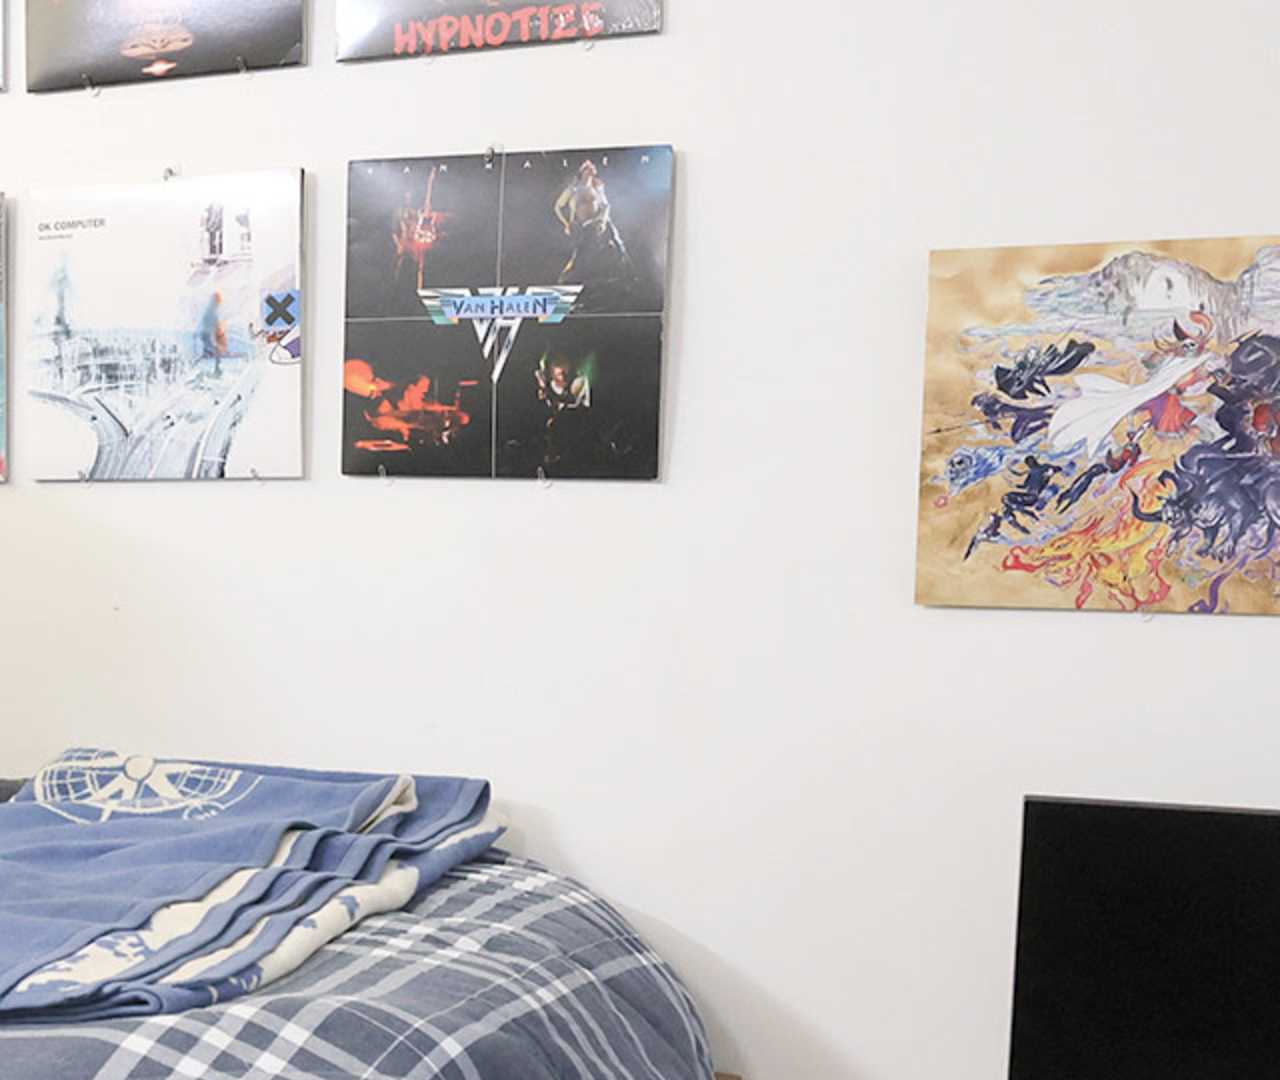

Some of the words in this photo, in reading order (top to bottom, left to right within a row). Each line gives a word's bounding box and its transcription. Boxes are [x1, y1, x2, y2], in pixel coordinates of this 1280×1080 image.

[394, 2, 604, 55] HYPNOTIZE
[38, 223, 52, 232] OK
[54, 218, 106, 231] COMPUTER
